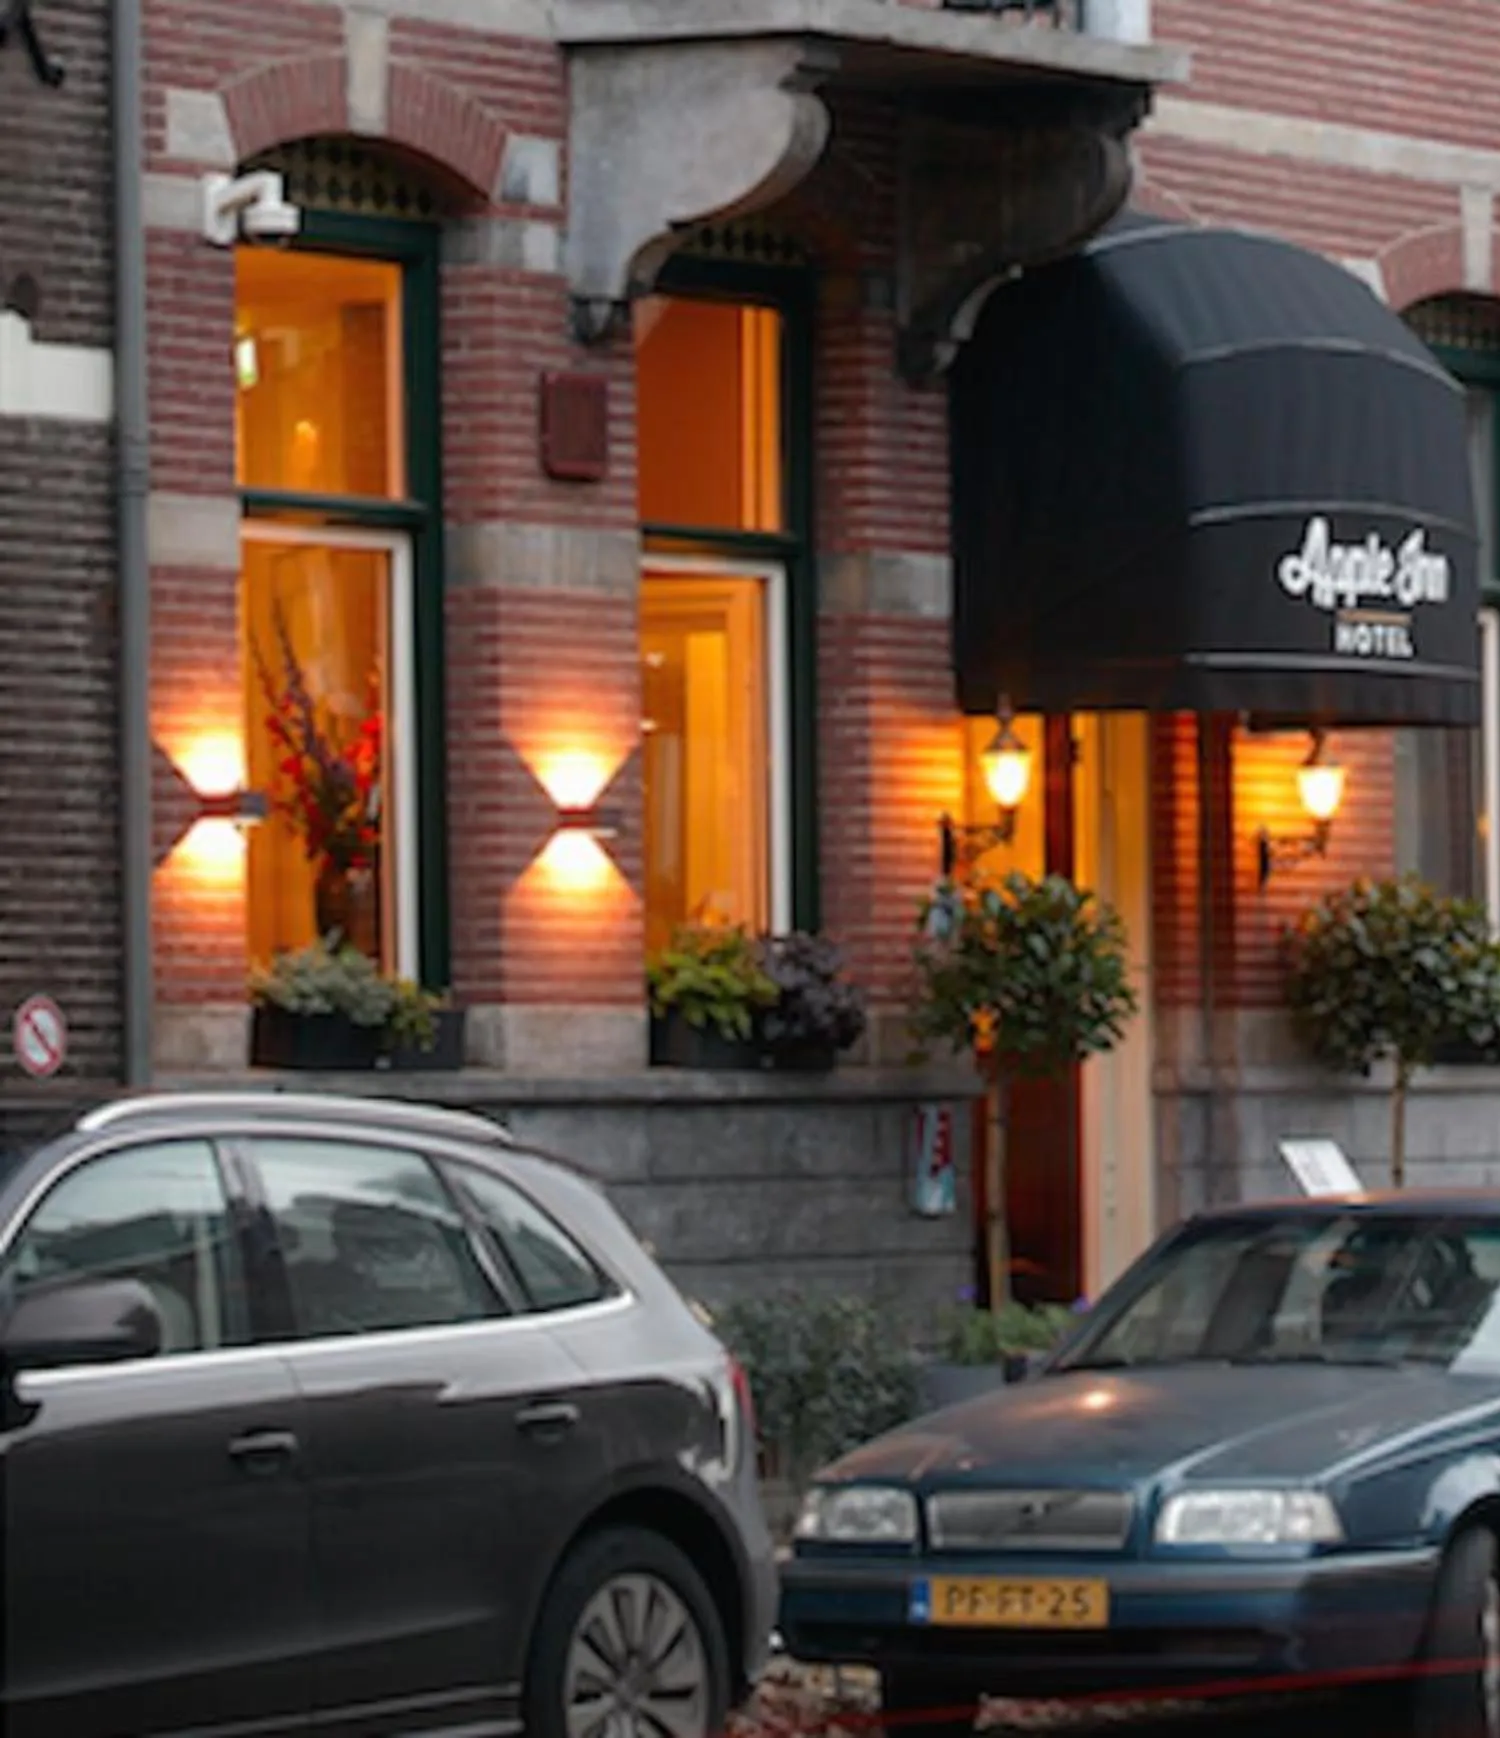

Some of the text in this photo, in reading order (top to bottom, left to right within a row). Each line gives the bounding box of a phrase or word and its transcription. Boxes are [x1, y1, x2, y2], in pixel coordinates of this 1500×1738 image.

[1278, 515, 1449, 609] Apple Inn
[1335, 624, 1414, 657] HOTEL
